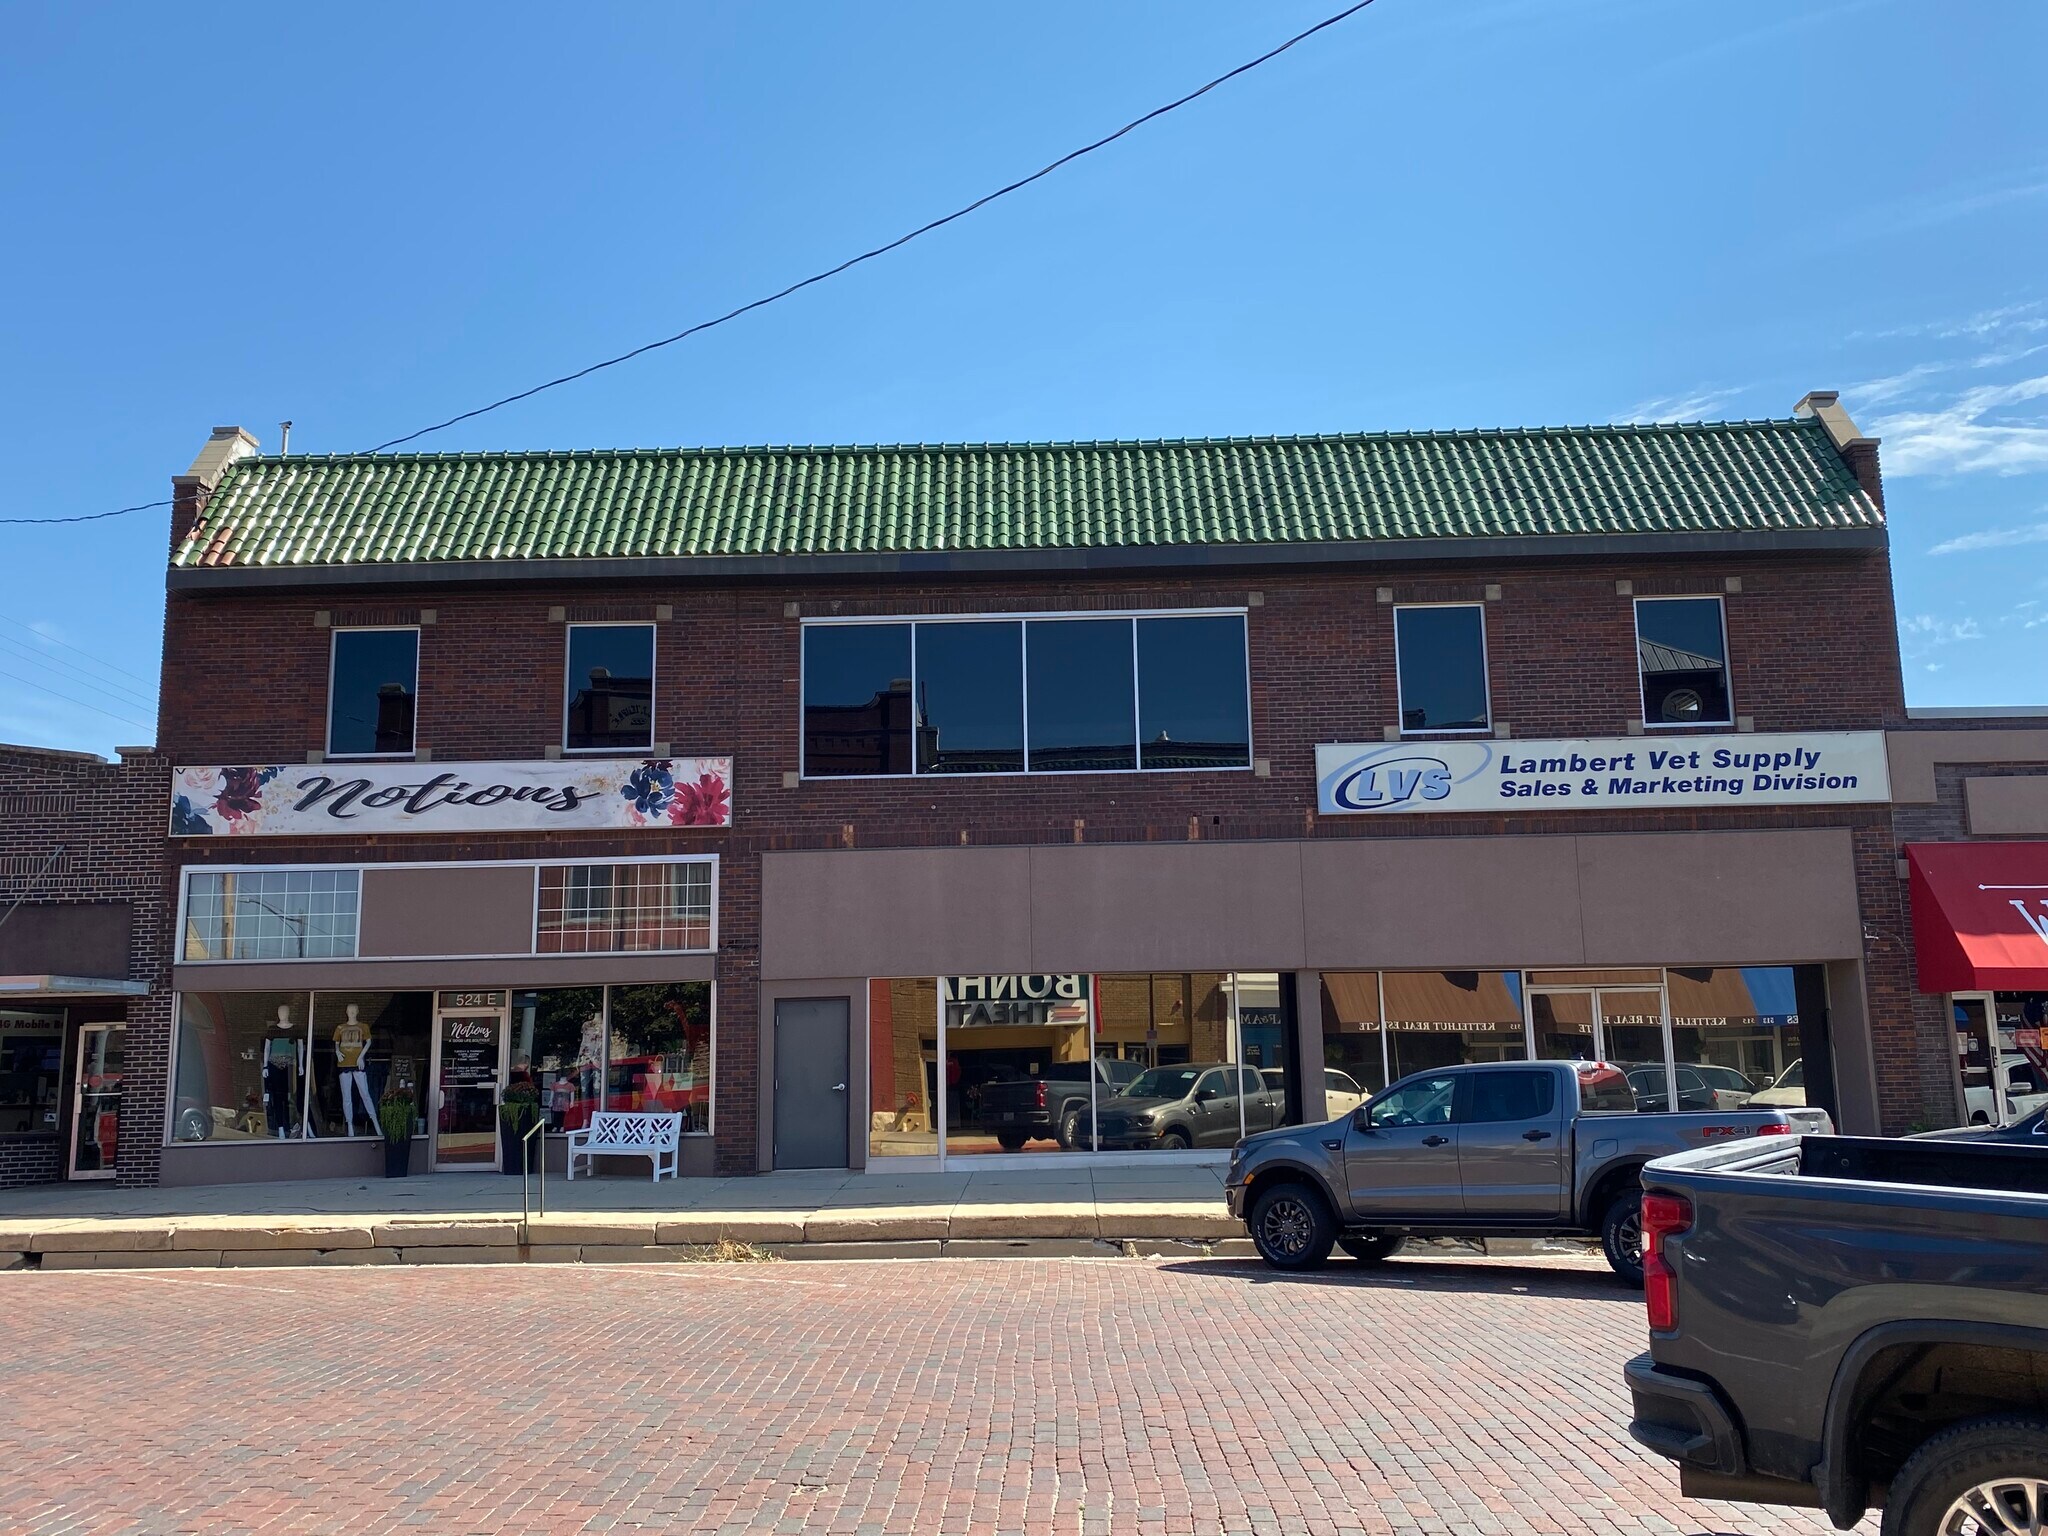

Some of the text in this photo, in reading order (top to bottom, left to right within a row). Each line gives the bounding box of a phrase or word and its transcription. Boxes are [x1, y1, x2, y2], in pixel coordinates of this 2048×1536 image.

[1500, 747, 1822, 774] Lambert Vet Supply
[1356, 768, 1452, 801] LVS
[1499, 773, 1858, 798] Sales & Marketing Division
[292, 772, 602, 819] Notions
[456, 993, 497, 1006] 524 E
[14, 1019, 50, 1029] Mobile
[451, 1021, 492, 1039] Notions
[1702, 1125, 1751, 1138] FX4
